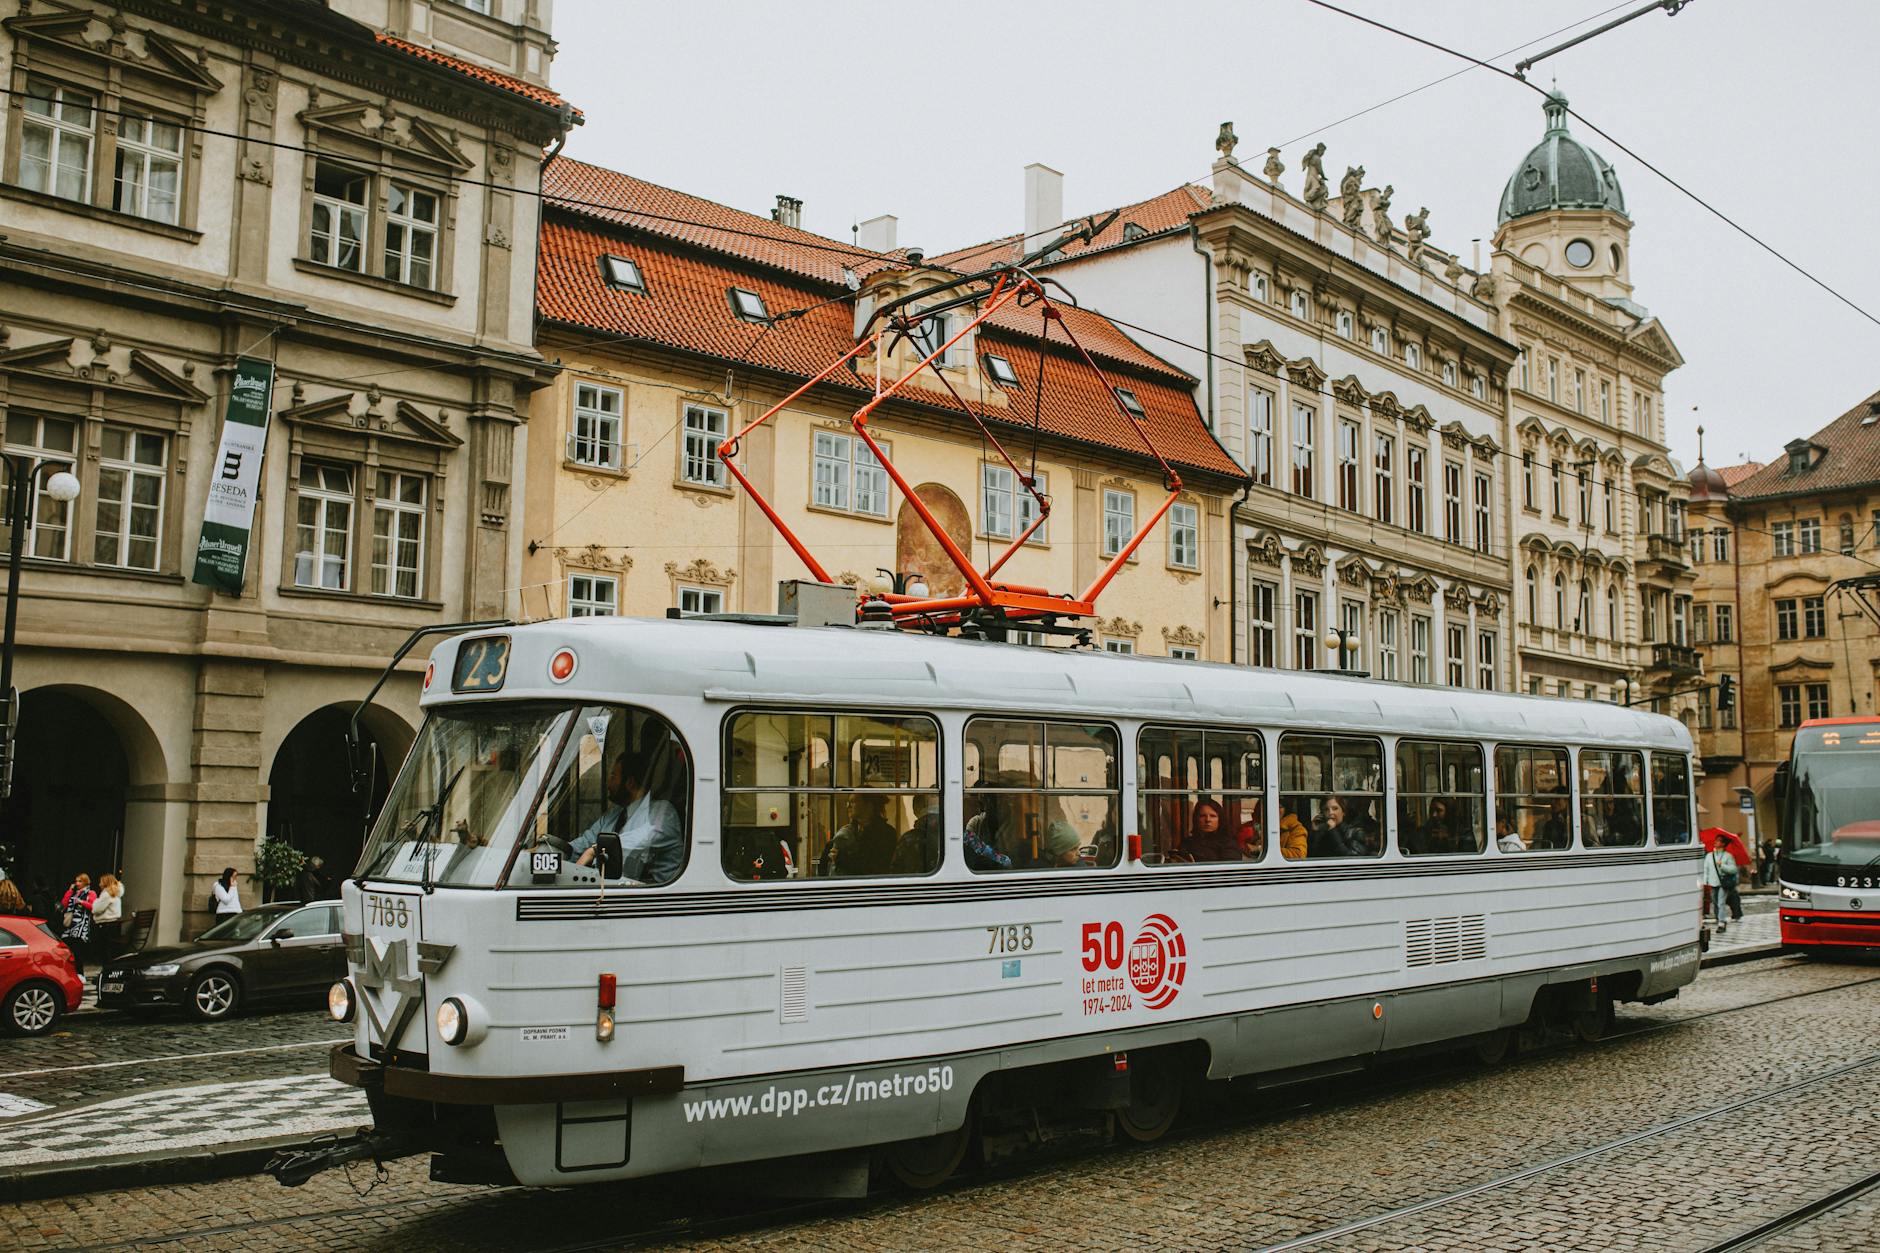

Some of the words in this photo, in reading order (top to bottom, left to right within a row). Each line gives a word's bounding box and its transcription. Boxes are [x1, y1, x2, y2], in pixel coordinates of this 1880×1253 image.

[211, 482, 248, 498] BESEDA
[463, 639, 509, 687] 23
[533, 853, 559, 871] 605
[369, 895, 409, 929] 7188
[986, 922, 1034, 954] 7188
[1081, 920, 1124, 972] 50
[1082, 977, 1095, 994] let
[1097, 976, 1124, 993] metra
[683, 1066, 953, 1123] www.dpp.cz/metro50
